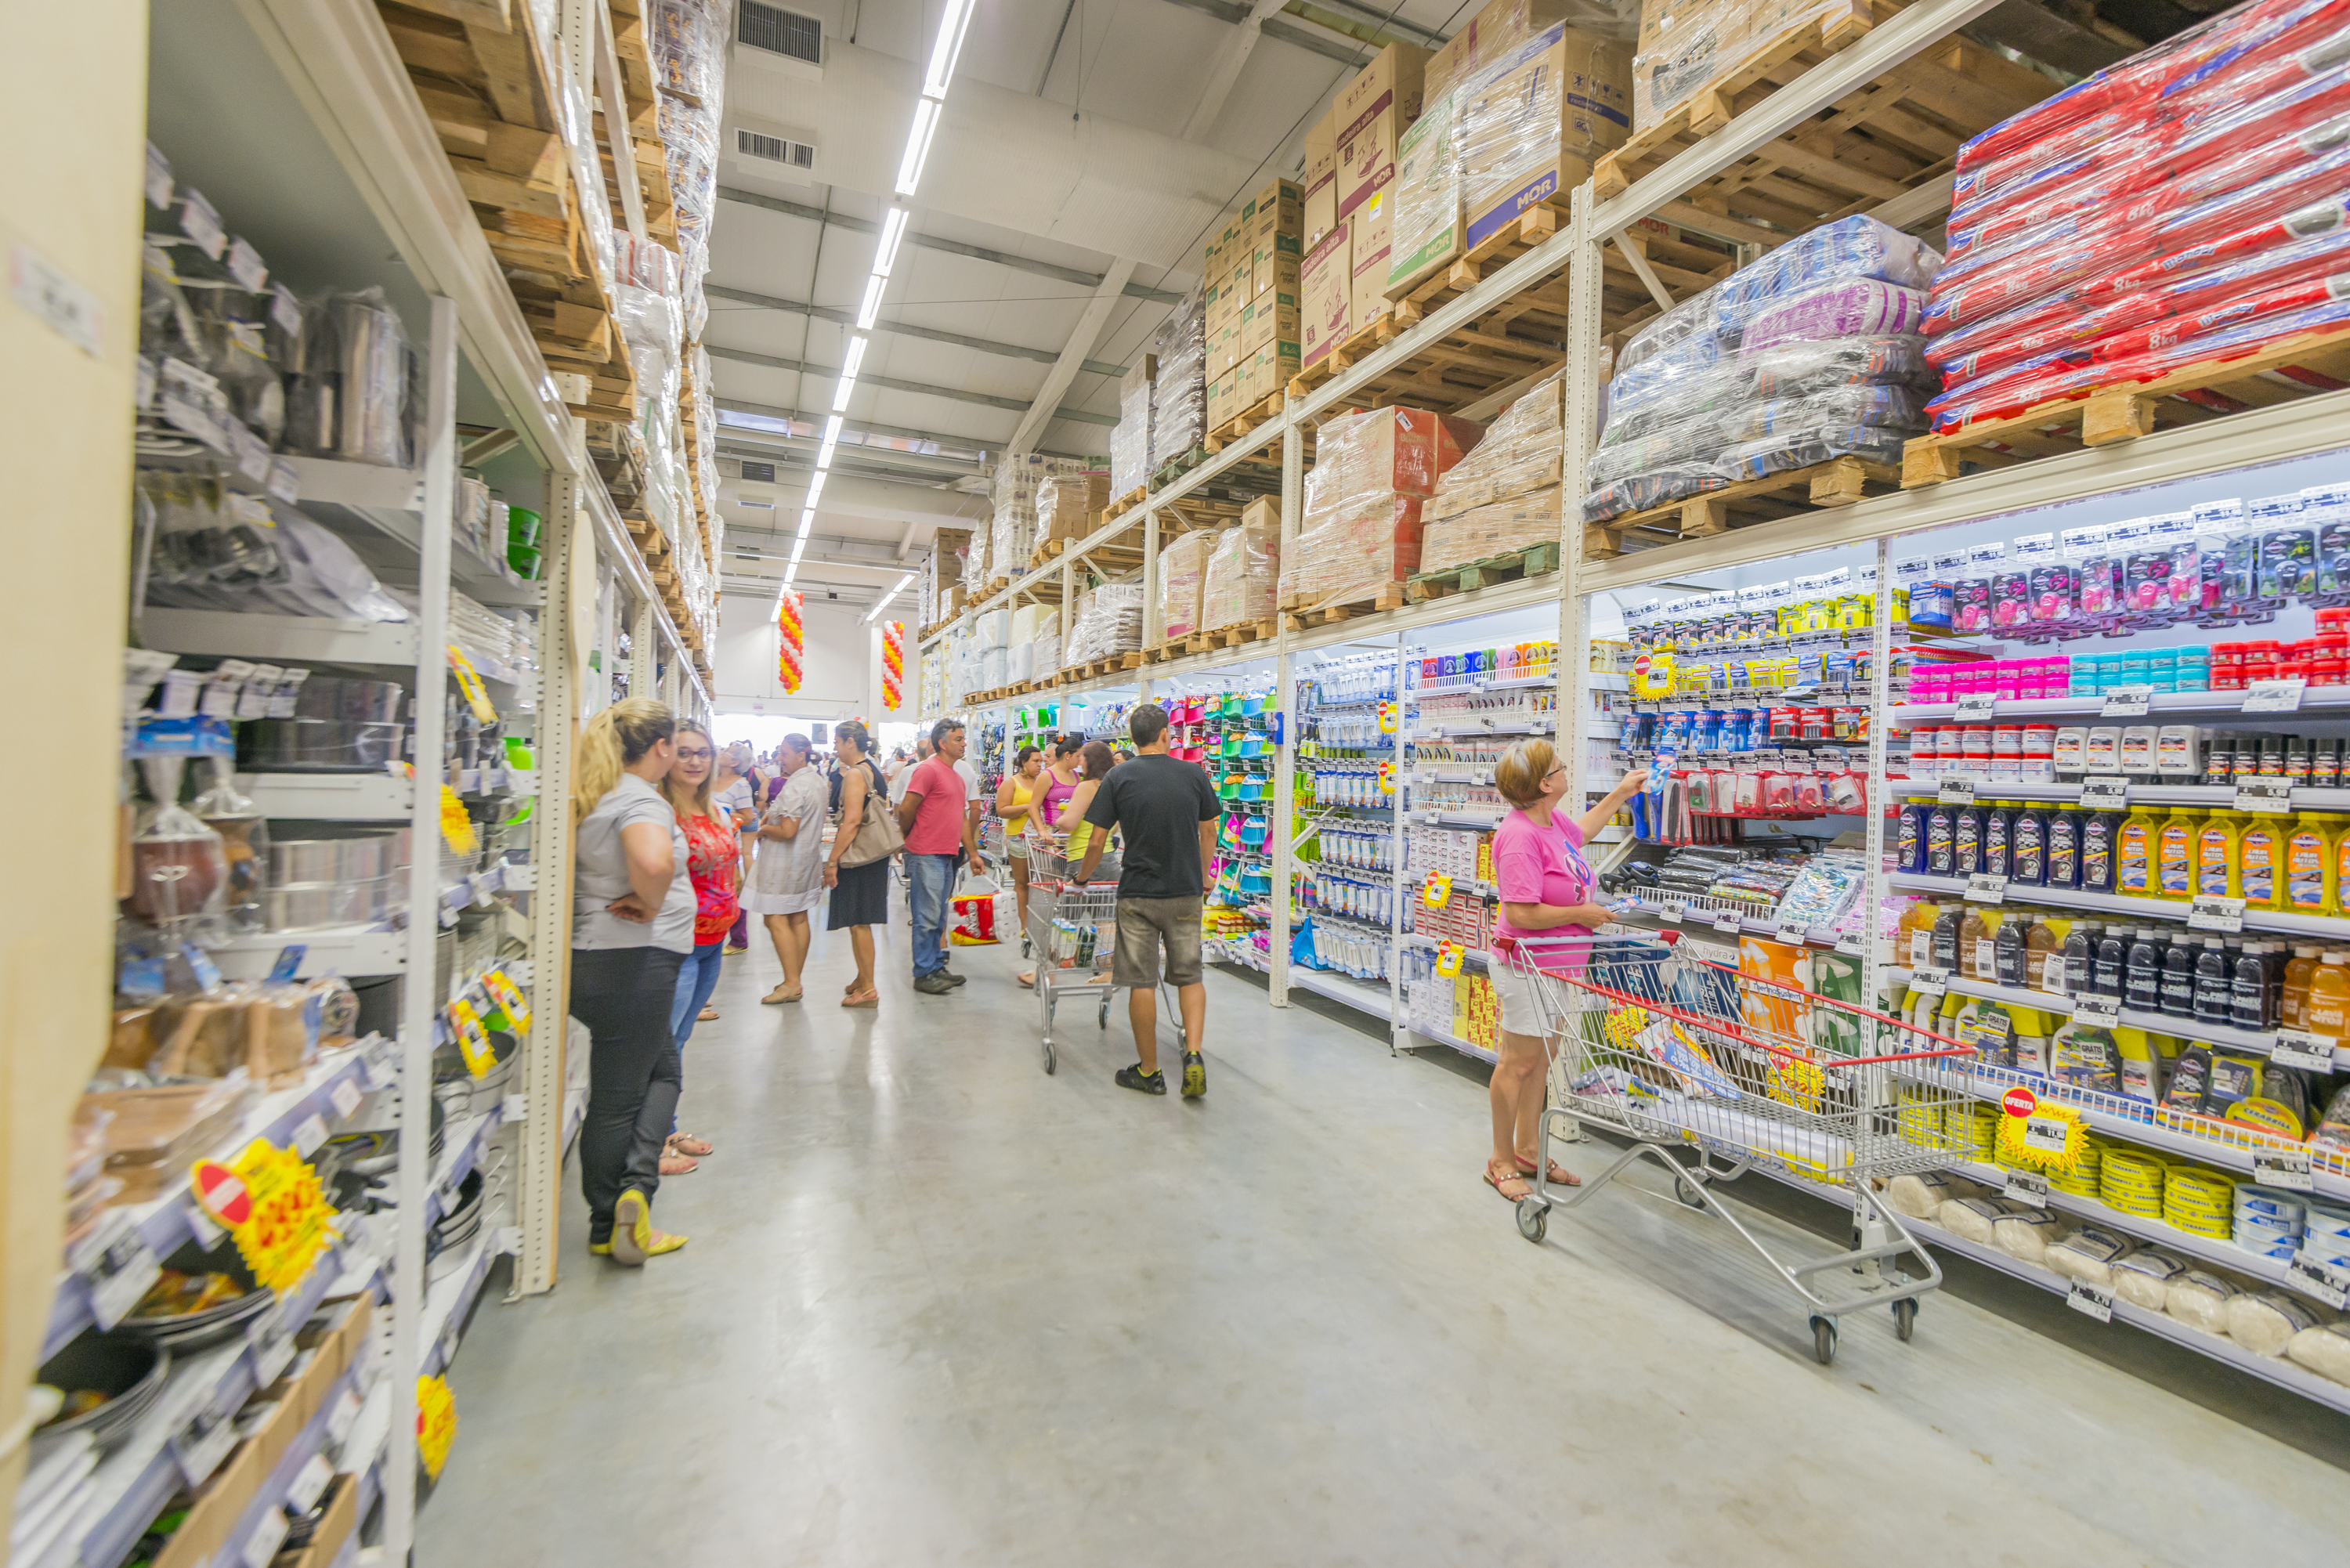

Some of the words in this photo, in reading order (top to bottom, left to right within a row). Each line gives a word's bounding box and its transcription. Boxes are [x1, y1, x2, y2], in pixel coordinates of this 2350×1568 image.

[1337, 122, 1361, 147] cadeira
[1361, 110, 1374, 126] alta
[1347, 148, 1352, 158] 6
[1373, 167, 1392, 187] MOR
[1517, 178, 1552, 211] MOR
[1637, 217, 1669, 236] MOR
[1310, 227, 1324, 244] MR
[1425, 232, 1450, 258] MOR
[1302, 249, 1325, 276] cadeira
[1325, 235, 1340, 253] alta
[2113, 278, 2142, 294] 8kg
[1365, 305, 1380, 323] MR
[1329, 327, 1348, 350] MOR
[2148, 333, 2178, 350] 8kg
[1280, 361, 1301, 370] GRANDE
[1703, 945, 1728, 959] hydra
[1988, 1014, 2009, 1026] GRÁTIS
[2081, 1043, 2103, 1054] GRÁTIS
[2004, 1096, 2034, 1111] OFERTA
[2243, 1107, 2292, 1130] CERABRILL
[2178, 1181, 2209, 1193] CERABRILL
[2178, 1195, 2211, 1206] CERABRILL
[2182, 1222, 2215, 1233] CERABRILL
